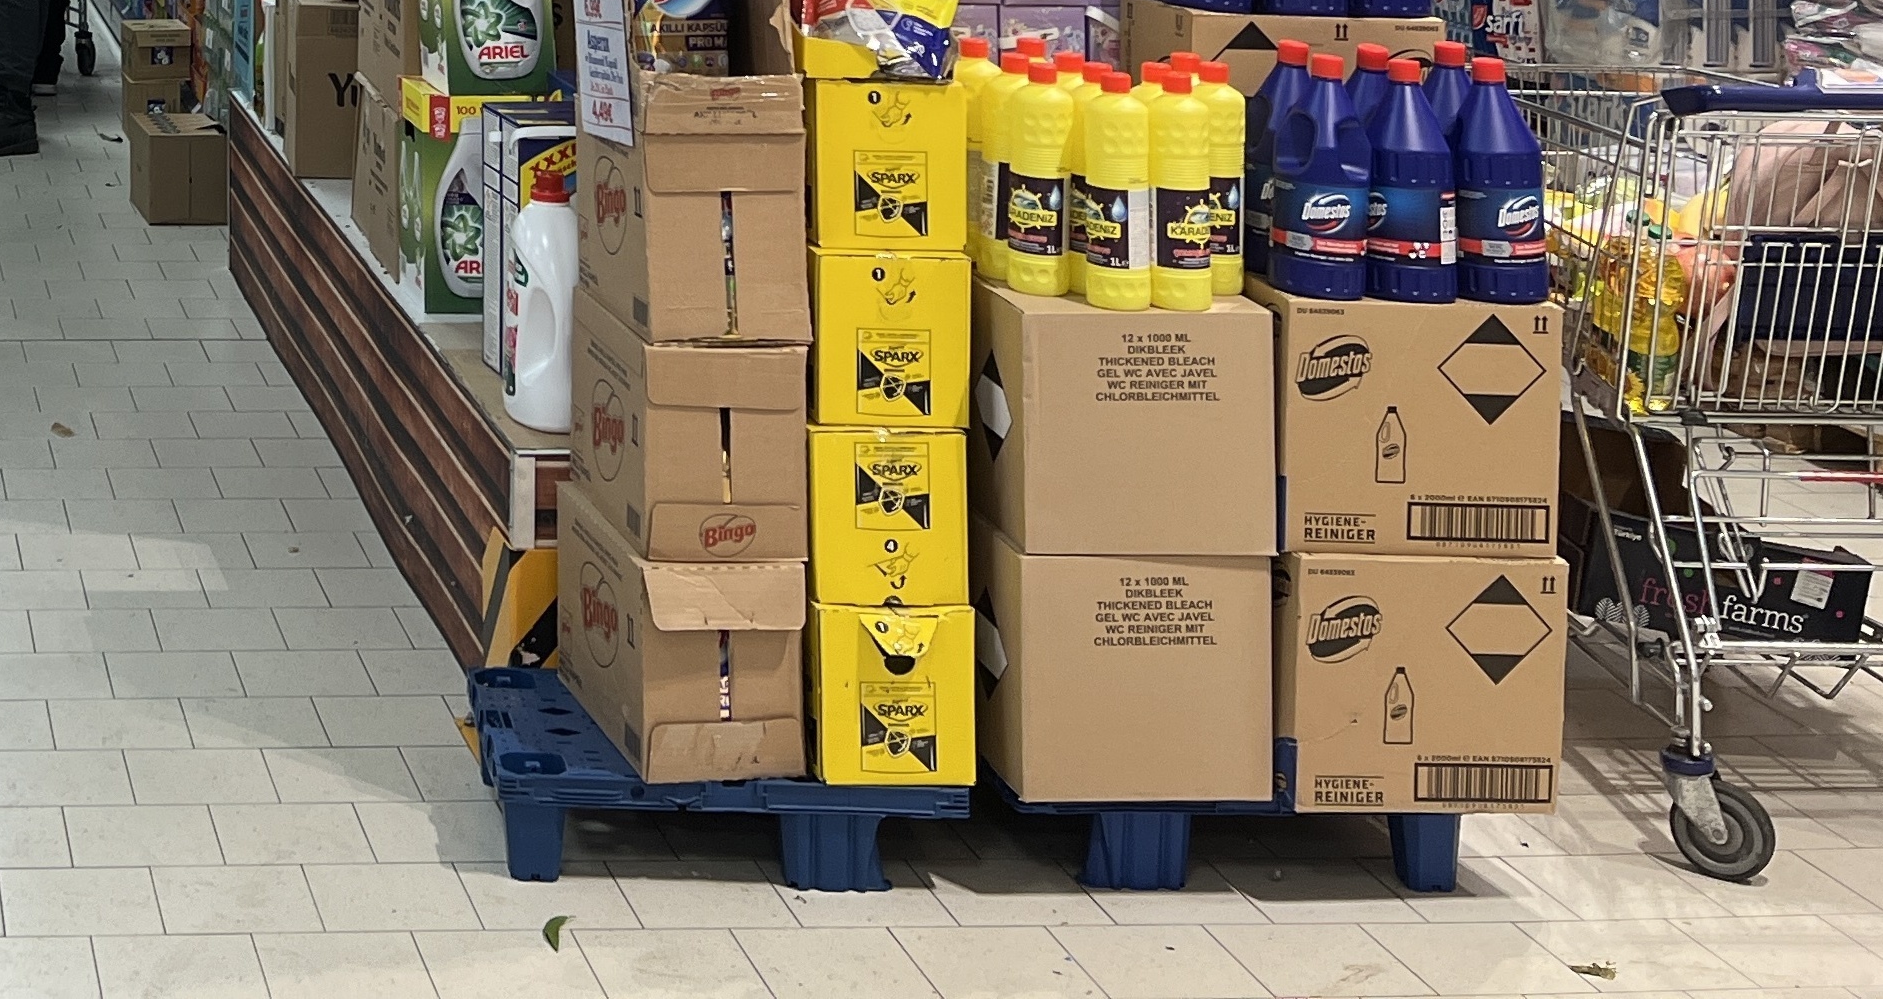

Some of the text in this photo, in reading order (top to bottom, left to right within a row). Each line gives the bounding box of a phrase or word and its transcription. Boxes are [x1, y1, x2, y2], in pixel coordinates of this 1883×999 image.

[689, 37, 713, 48] PRO
[478, 44, 529, 60] ARIEL
[457, 105, 476, 115] 100
[871, 171, 917, 184] SPARX
[596, 185, 626, 225] Bingo
[1301, 198, 1352, 221] Domestos
[1497, 204, 1539, 228] Domestos
[1121, 334, 1132, 342] 12
[1146, 334, 1171, 342] 1000
[1175, 334, 1191, 342] ML
[1128, 345, 1185, 354] DIKBLEEK
[873, 349, 920, 363] SPARX
[1098, 357, 1215, 366] THICKENED BLEACH
[1295, 348, 1374, 382] Domestos
[1097, 369, 1217, 378] GEL WC AVEC JAVEL
[1107, 380, 1207, 389] WC REINIGER MIT
[1096, 391, 1220, 402] CHLORBLEICHMITTEL
[594, 407, 625, 456] Bingo
[872, 463, 919, 477] SPARX
[1304, 516, 1367, 527] HYGIENE-
[704, 522, 756, 548] Bingo
[1305, 528, 1376, 540] REINIGER
[1120, 577, 1130, 586] 12
[1143, 577, 1169, 586] 1000
[1173, 577, 1189, 586] ML
[1126, 589, 1183, 598] DIKBLEEK
[1097, 600, 1212, 610] THICKENED BLEACH
[583, 587, 619, 640] Bingo
[1095, 612, 1214, 622] GEL WC AVEC JAVEL
[1720, 594, 1805, 634] farms
[1105, 624, 1204, 634] WC REINIGER MIT
[1306, 611, 1383, 645] Domestos
[1094, 635, 1218, 646] CHLORBLEICHMITTEL
[877, 704, 924, 718] SPARX
[1315, 779, 1374, 790] HYGIENE-
[1315, 791, 1384, 804] REINIGER
